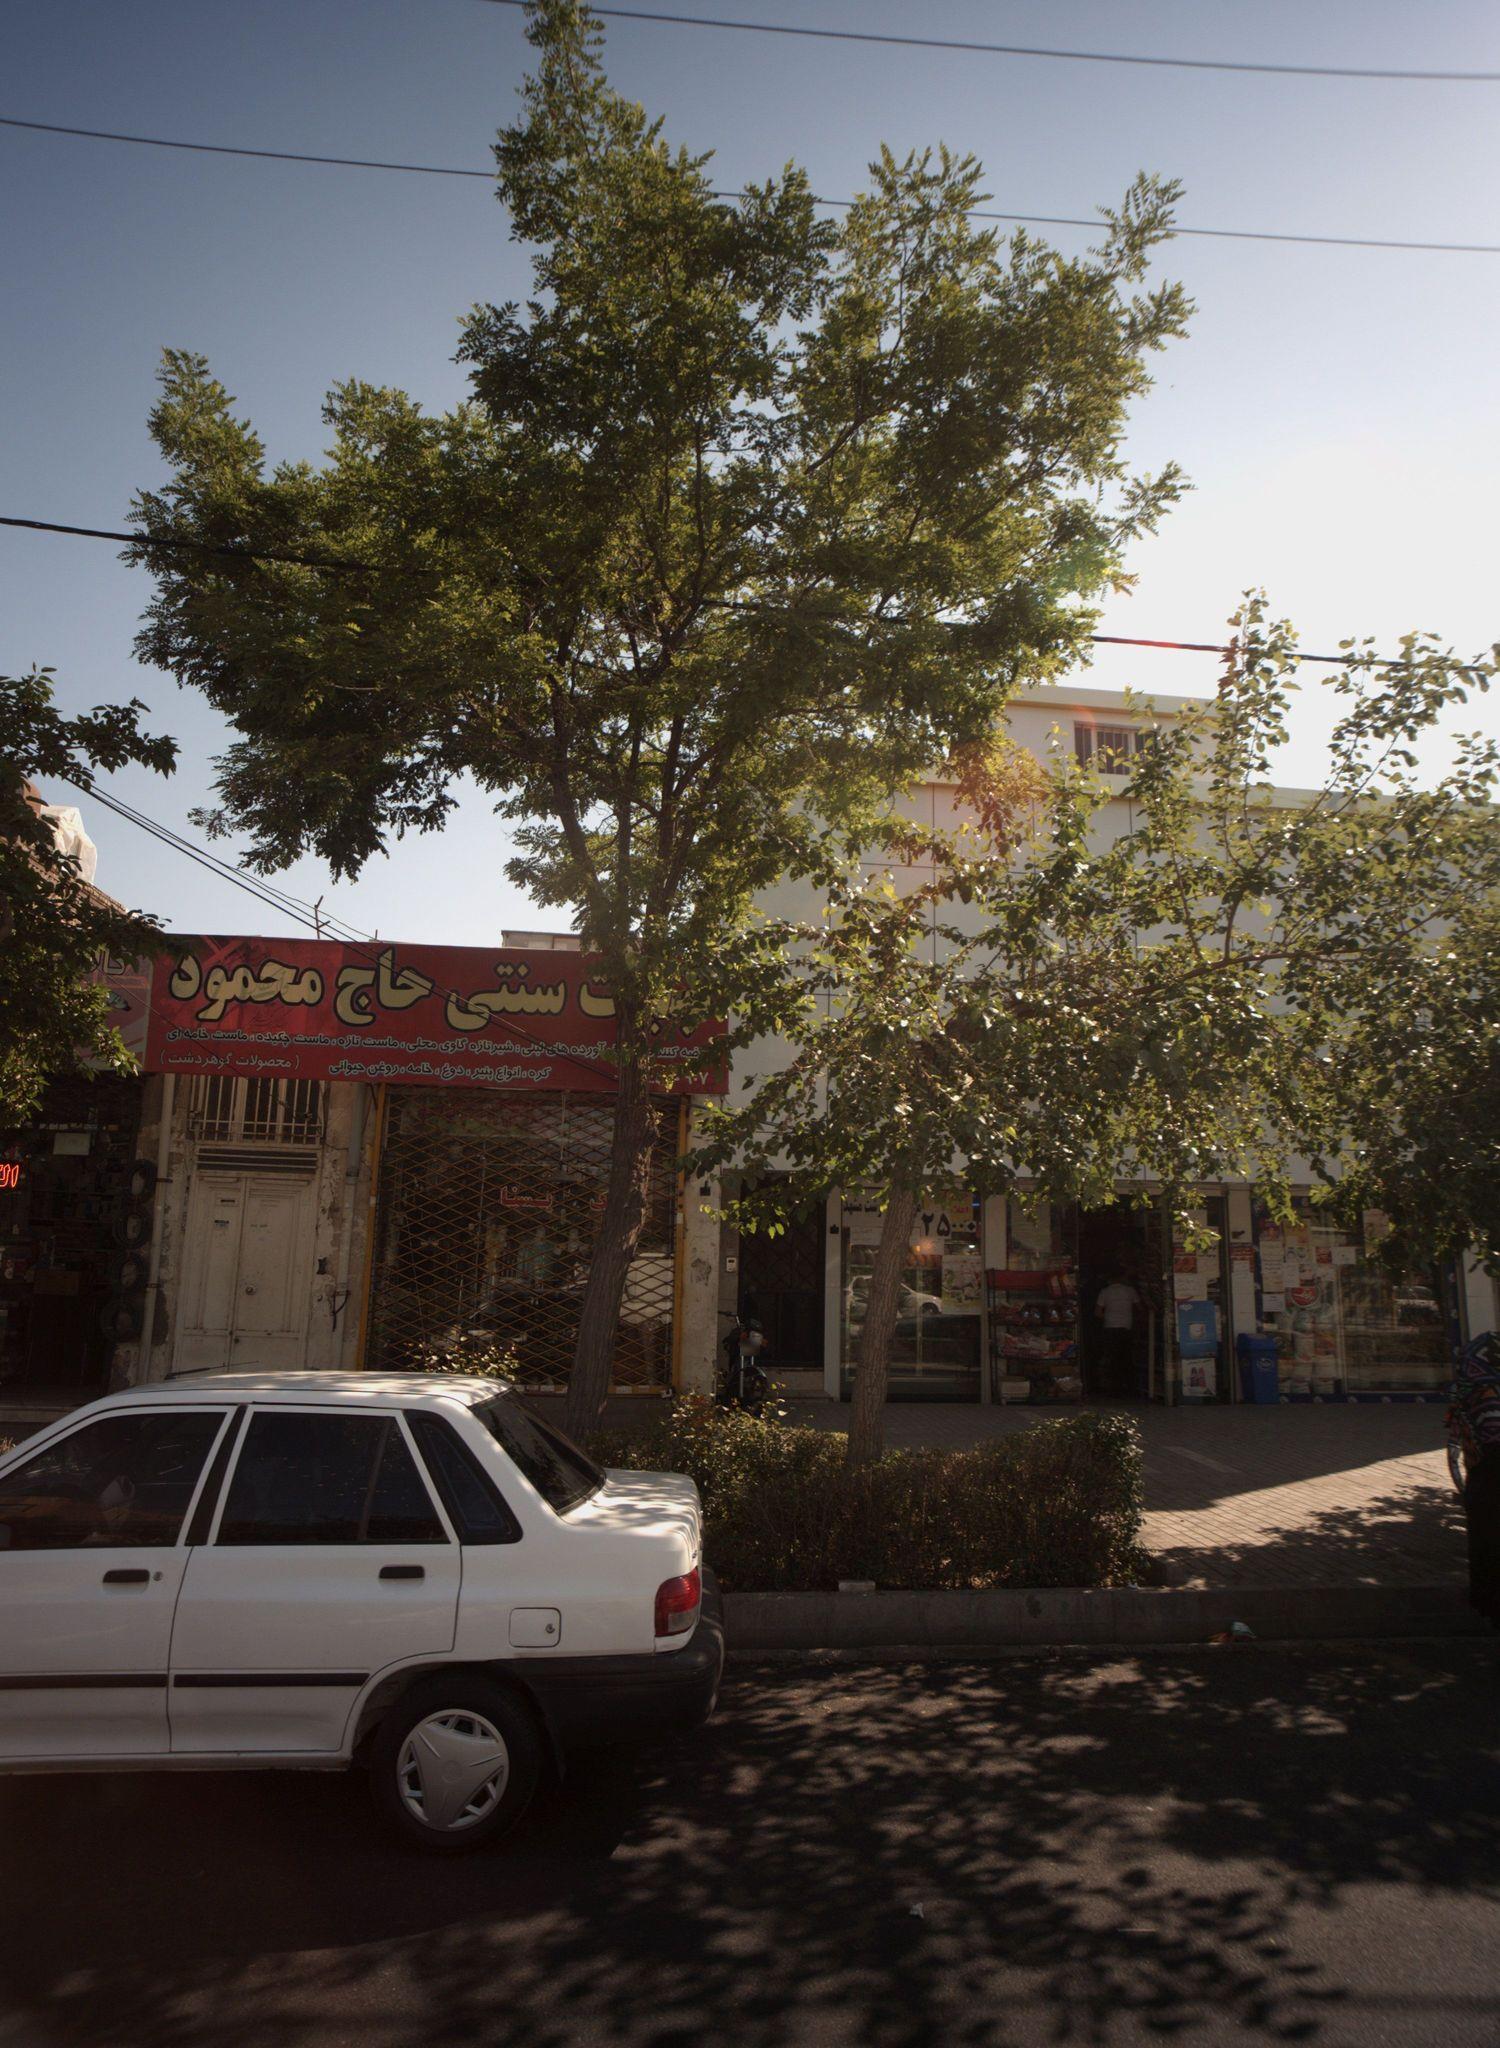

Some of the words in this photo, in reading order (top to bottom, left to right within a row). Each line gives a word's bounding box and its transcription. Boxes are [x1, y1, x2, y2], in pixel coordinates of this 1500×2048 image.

[168, 953, 325, 1022] محمود
[333, 948, 435, 1027] حاج
[444, 961, 567, 1032] سنتی
[210, 1029, 249, 1042] ماست
[292, 1033, 330, 1046] ماست
[361, 1036, 399, 1049] ماست
[328, 1060, 366, 1077] حیوانی
[366, 1062, 399, 1077] روغن
